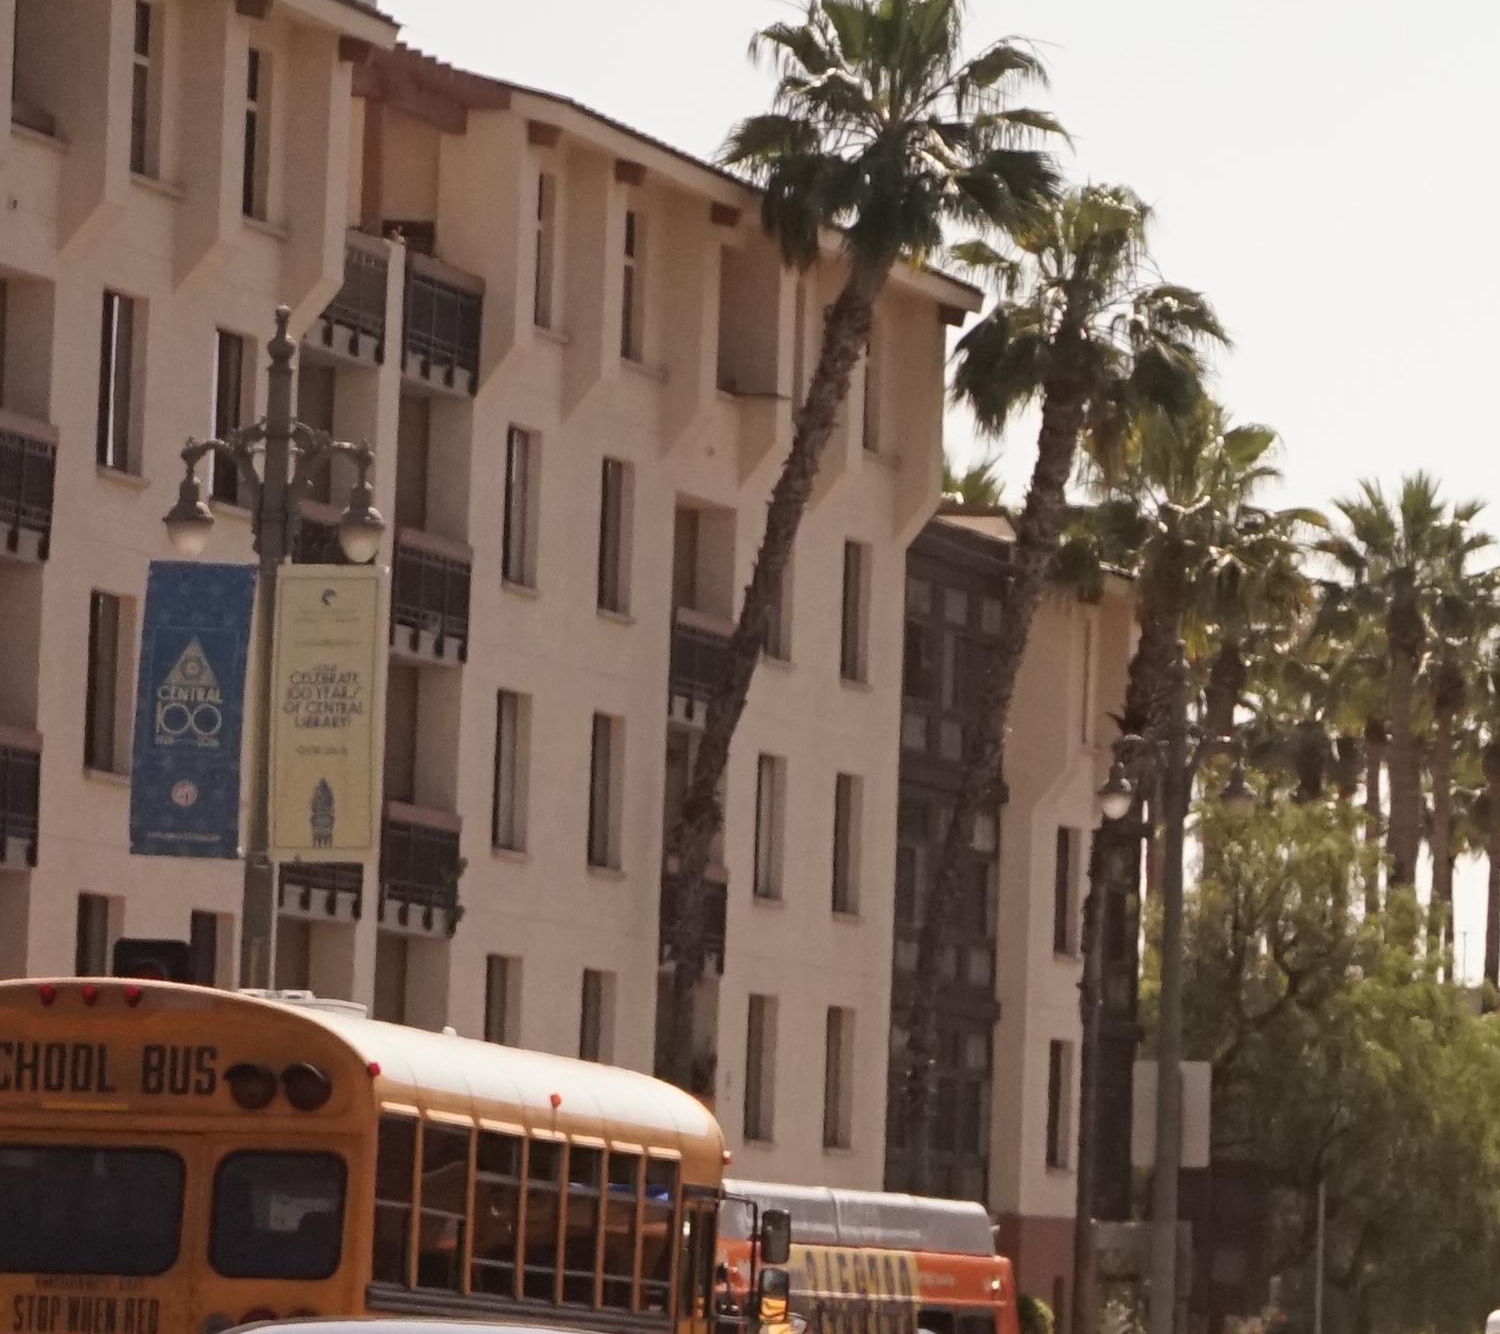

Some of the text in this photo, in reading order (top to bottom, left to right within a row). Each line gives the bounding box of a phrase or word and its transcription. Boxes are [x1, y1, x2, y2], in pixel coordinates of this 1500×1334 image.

[156, 702, 223, 736] 100
[0, 1041, 219, 1096] CHOOL BUS
[13, 1294, 161, 1334] STOP WHEN RED
